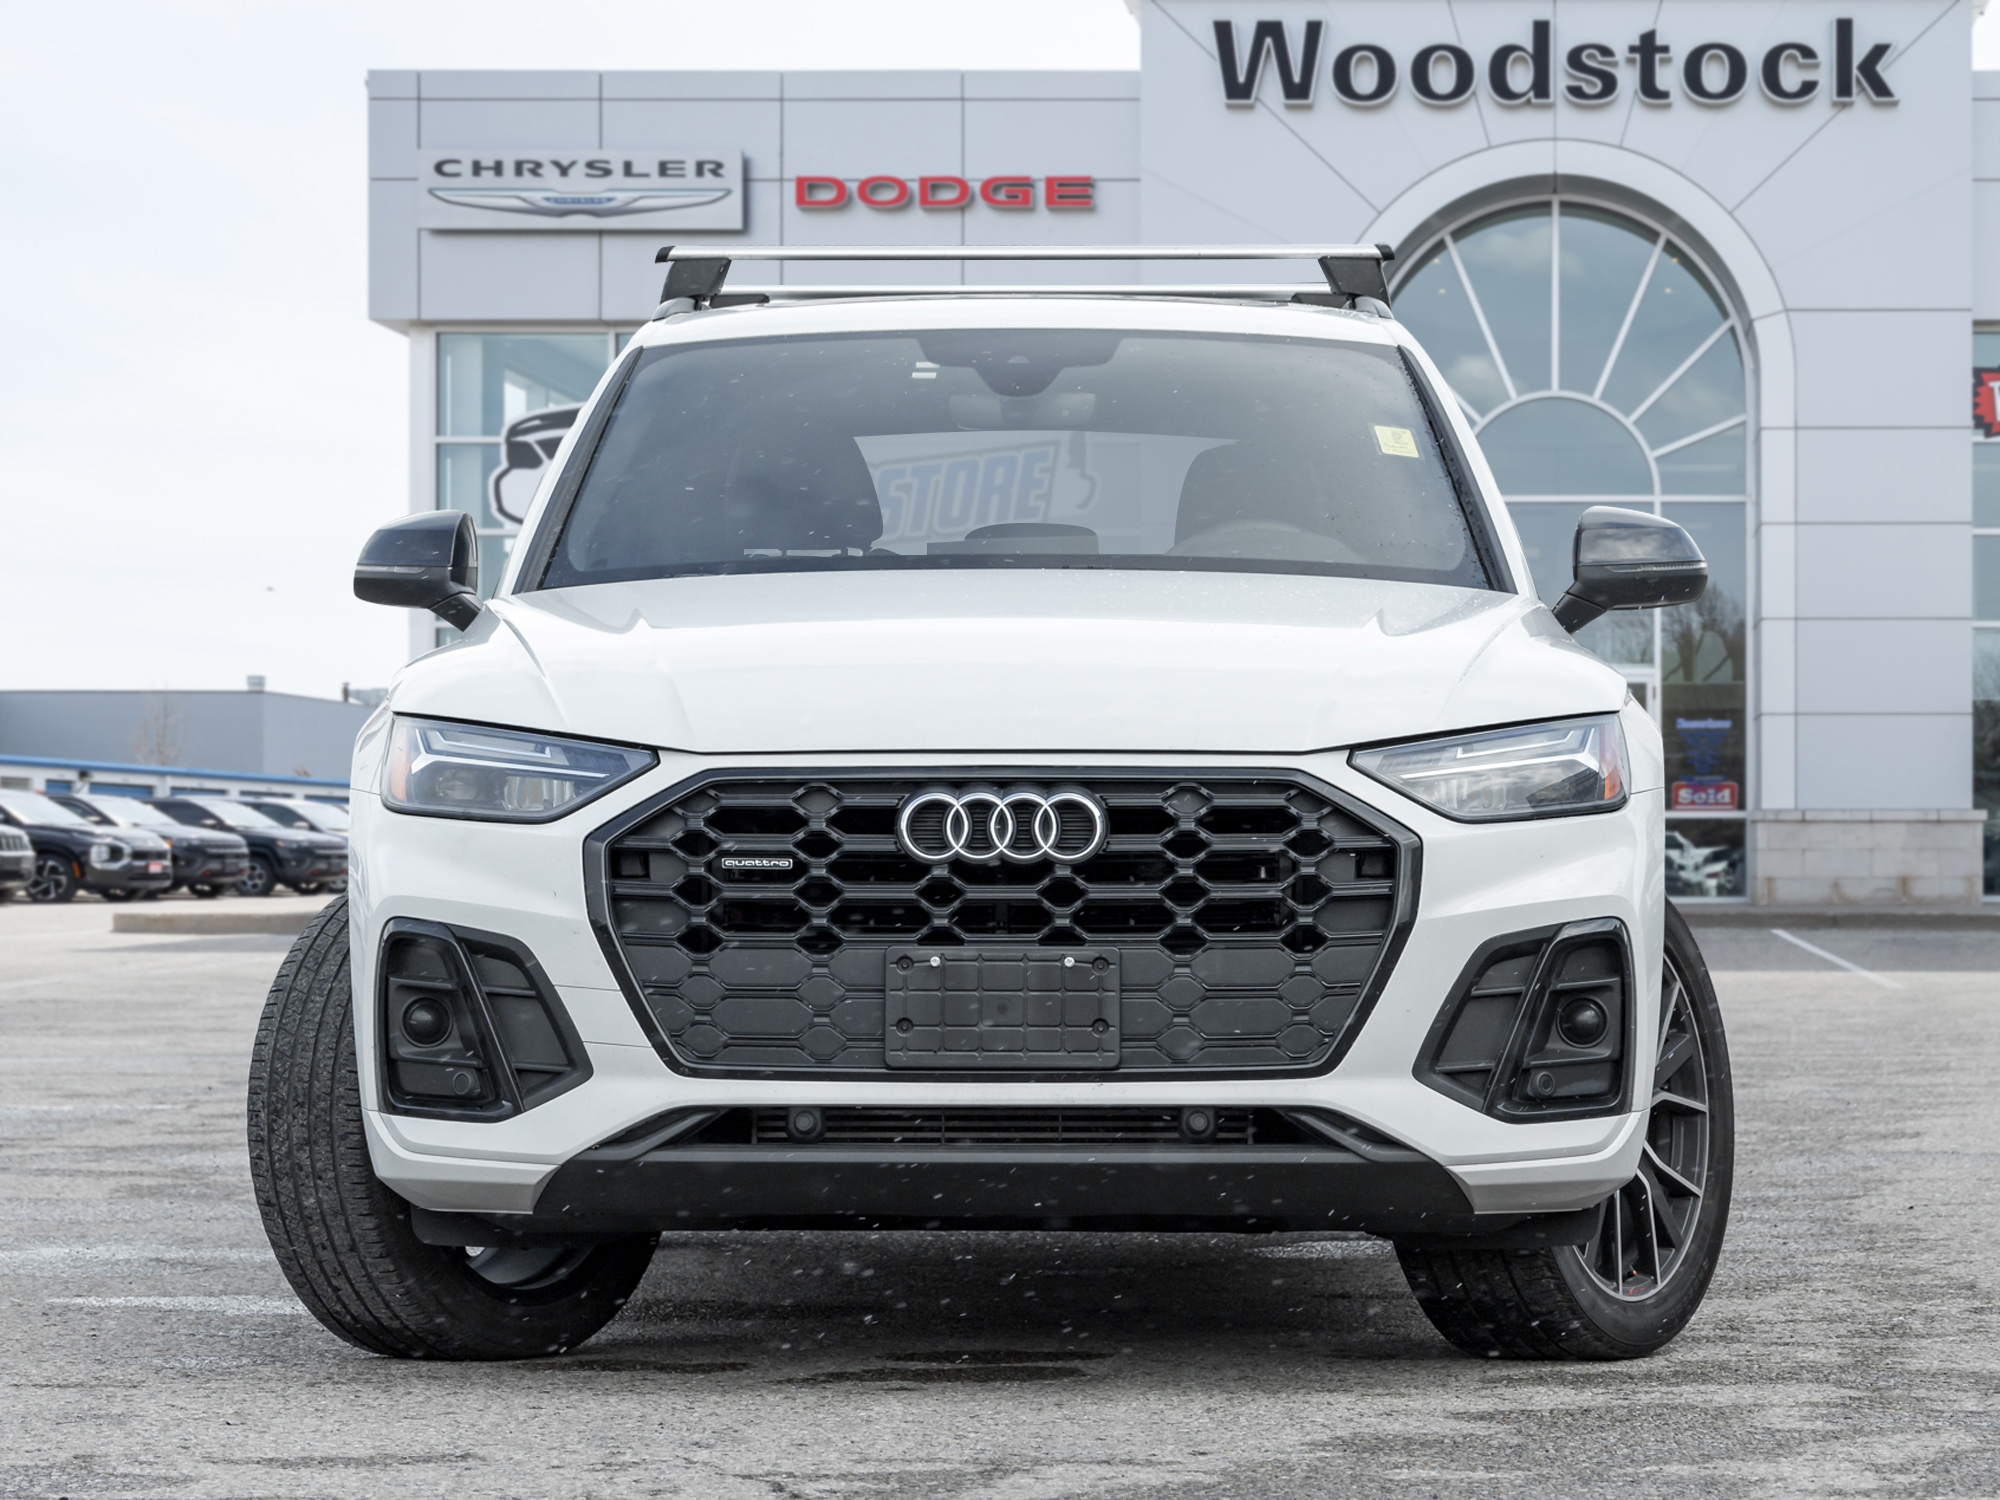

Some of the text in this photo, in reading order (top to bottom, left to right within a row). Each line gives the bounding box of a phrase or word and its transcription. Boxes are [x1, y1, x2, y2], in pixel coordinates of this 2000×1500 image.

[1213, 17, 1897, 103] Woodstock
[433, 159, 725, 178] CHRYSLER
[795, 175, 1093, 207] DODGE
[1678, 788, 1732, 804] Sold
[724, 859, 790, 867] quattro
